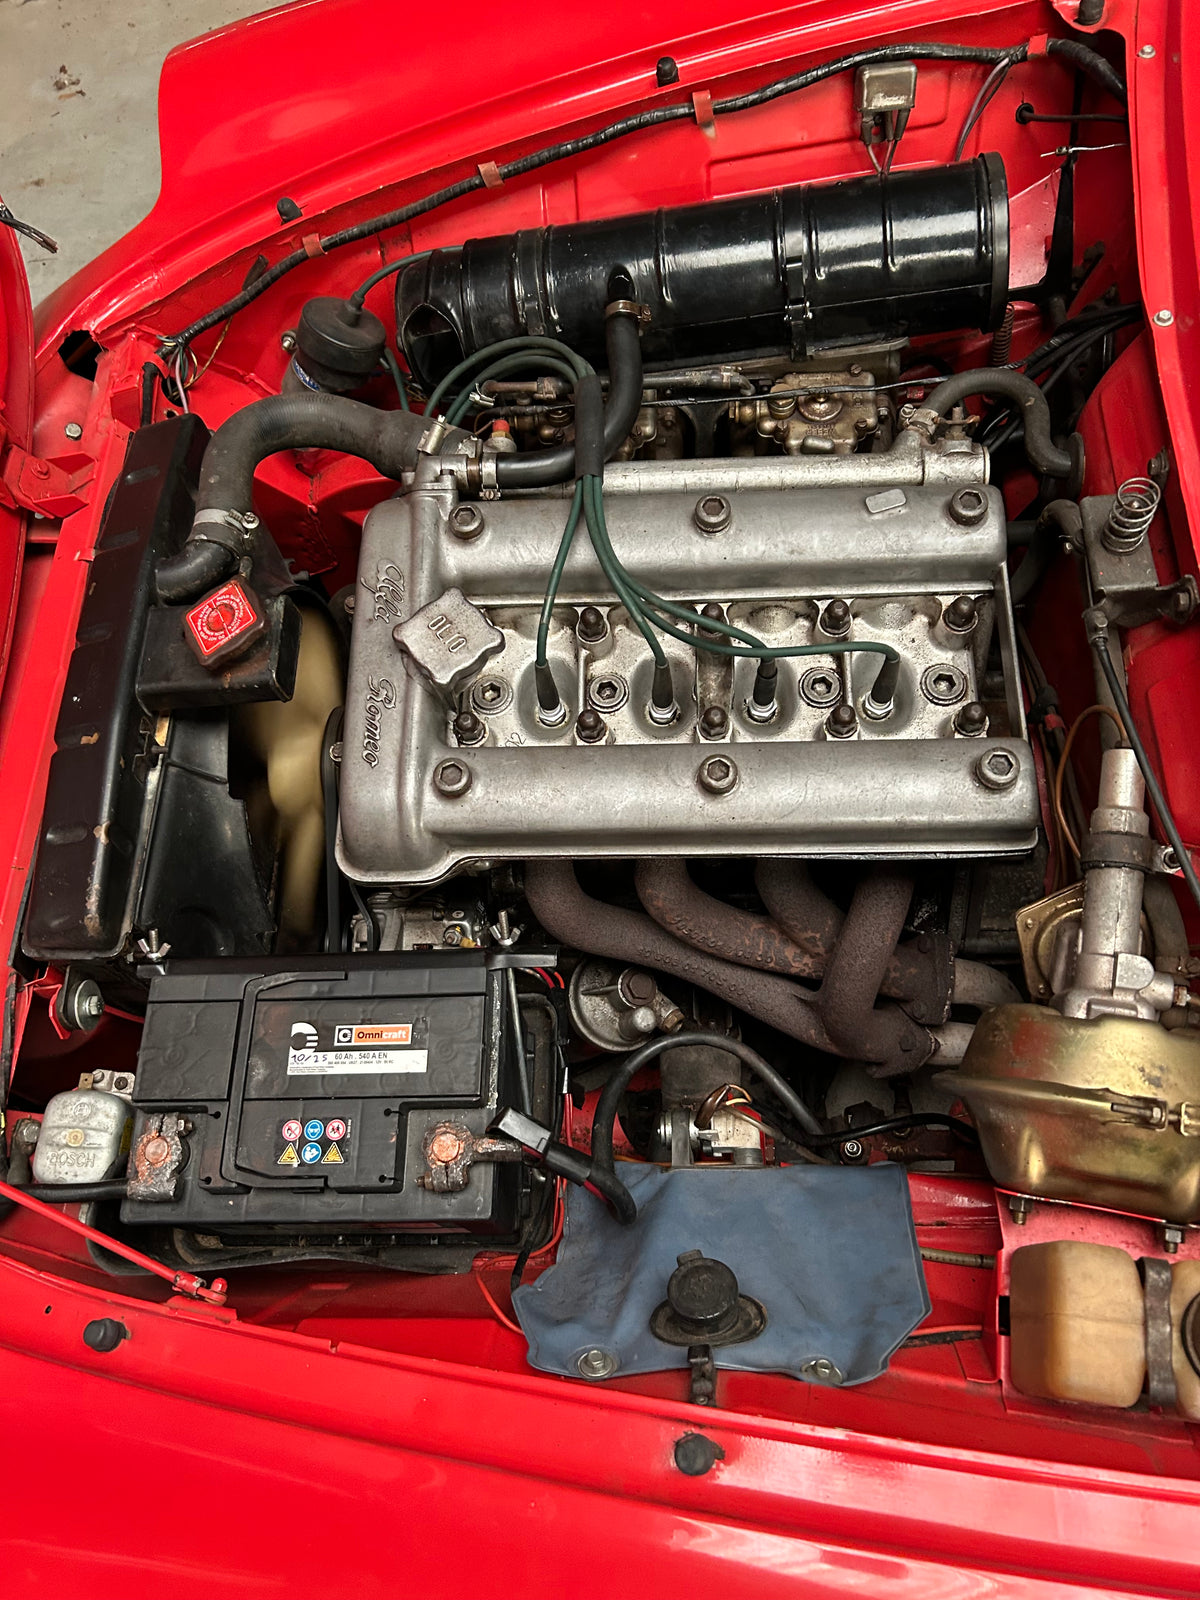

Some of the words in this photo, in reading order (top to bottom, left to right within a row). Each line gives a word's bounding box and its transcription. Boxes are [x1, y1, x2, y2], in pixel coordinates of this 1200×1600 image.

[360, 558, 405, 623] Alfa
[428, 615, 467, 653] OLIO
[362, 675, 396, 768] Romeo
[357, 1030, 407, 1039] Omnicraft
[46, 1150, 96, 1168] BOSCH
